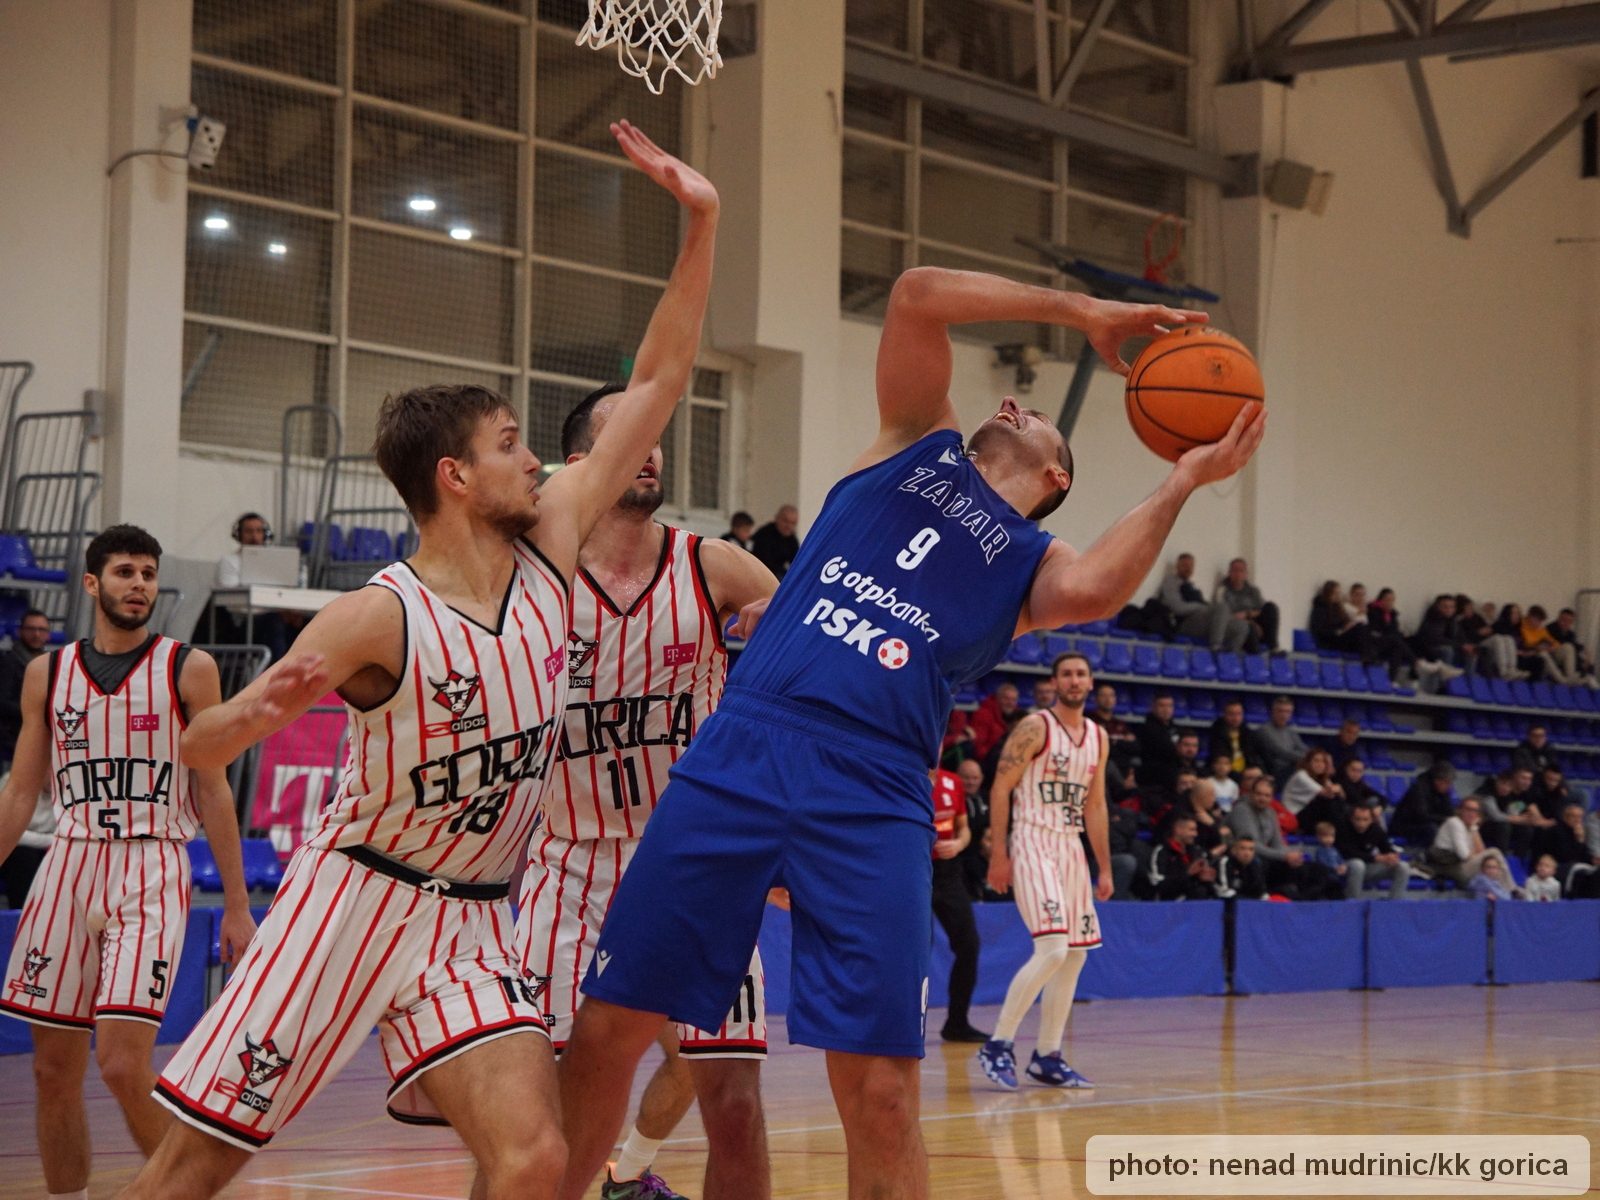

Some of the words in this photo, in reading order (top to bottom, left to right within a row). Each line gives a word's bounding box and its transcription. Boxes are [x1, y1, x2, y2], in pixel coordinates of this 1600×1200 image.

[898, 466, 1010, 566] ZADAR
[895, 526, 941, 571] 9
[64, 740, 89, 750] alpas
[450, 716, 487, 733] alpas
[555, 692, 694, 763] ORICA
[56, 757, 174, 810] GORICA
[607, 756, 642, 810] 11
[98, 809, 121, 840] 5
[447, 789, 509, 835] 18
[149, 960, 169, 1000] 5
[240, 1091, 272, 1112] alpa
